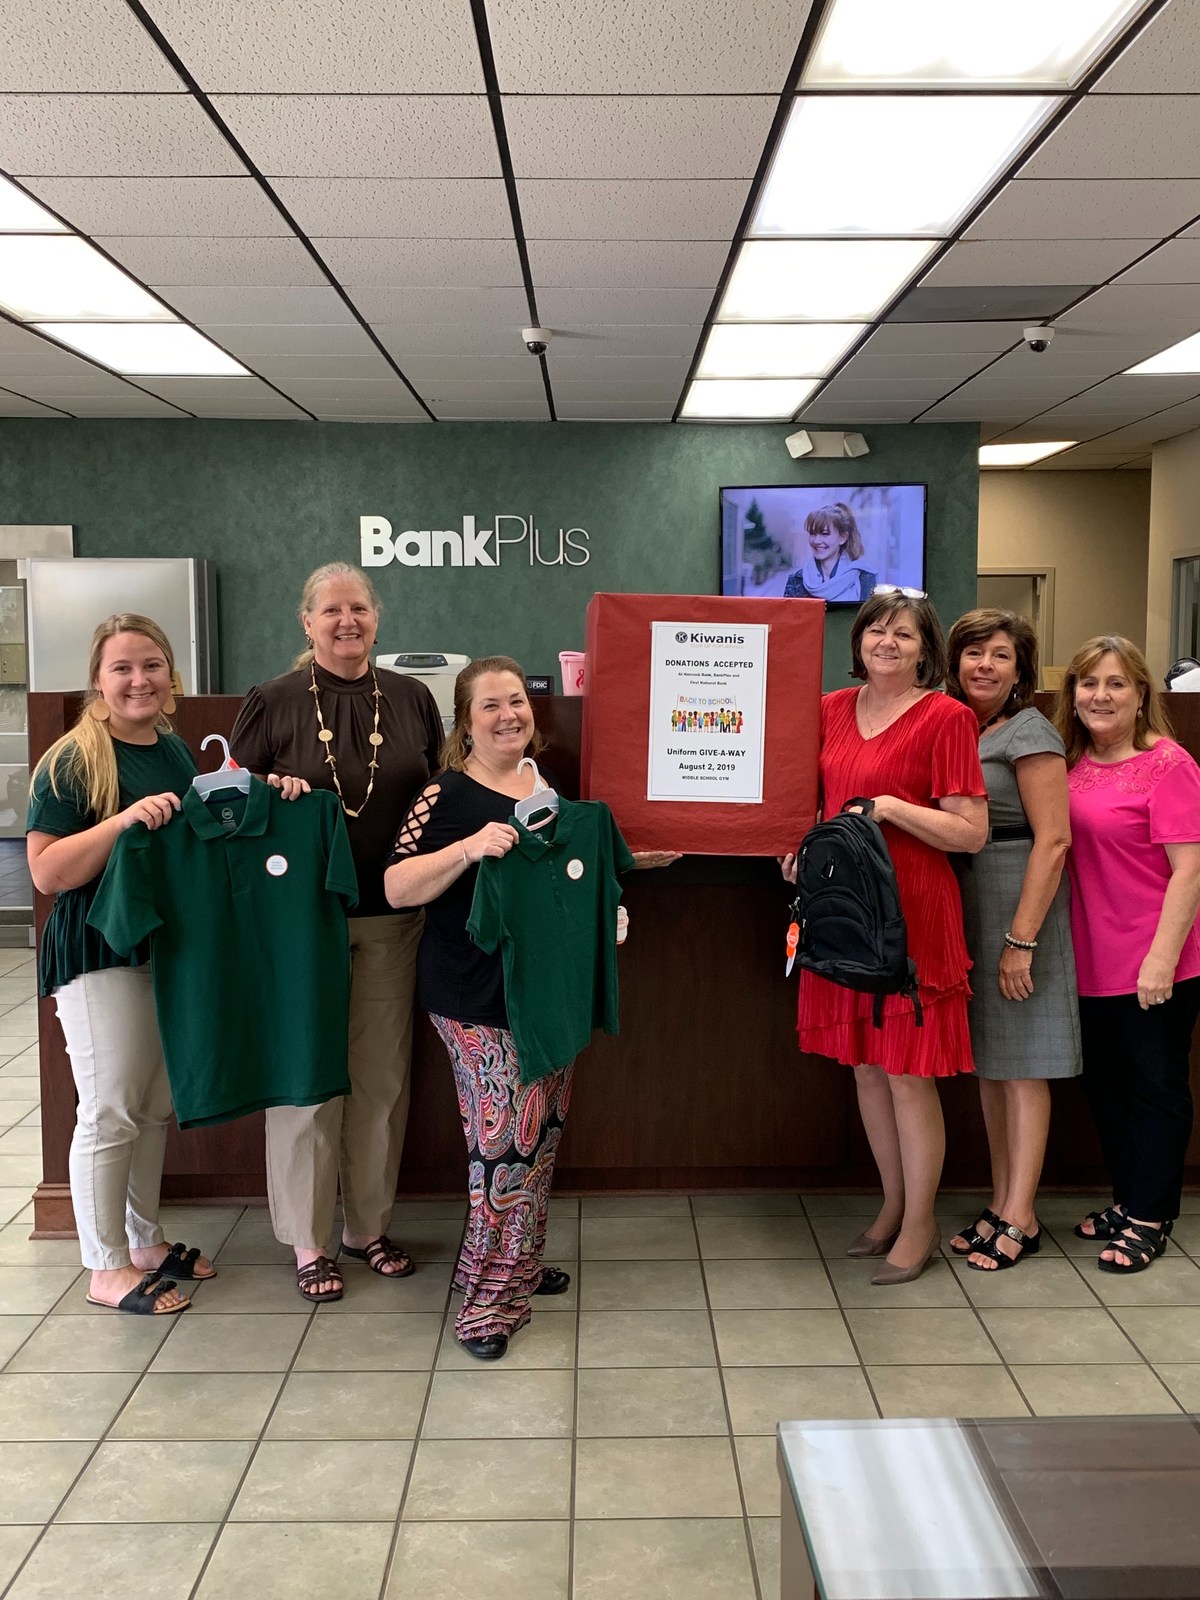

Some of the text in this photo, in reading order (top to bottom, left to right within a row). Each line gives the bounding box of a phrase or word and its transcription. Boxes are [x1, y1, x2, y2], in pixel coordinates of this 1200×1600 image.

[360, 514, 590, 567] BankPlus
[690, 633, 744, 644] Kiwanis
[680, 696, 697, 704] BACK
[708, 697, 733, 705] SCHOOL
[667, 748, 746, 757] Uniform GIVE-A-WAY
[679, 763, 705, 772] August
[707, 764, 715, 772] 2,
